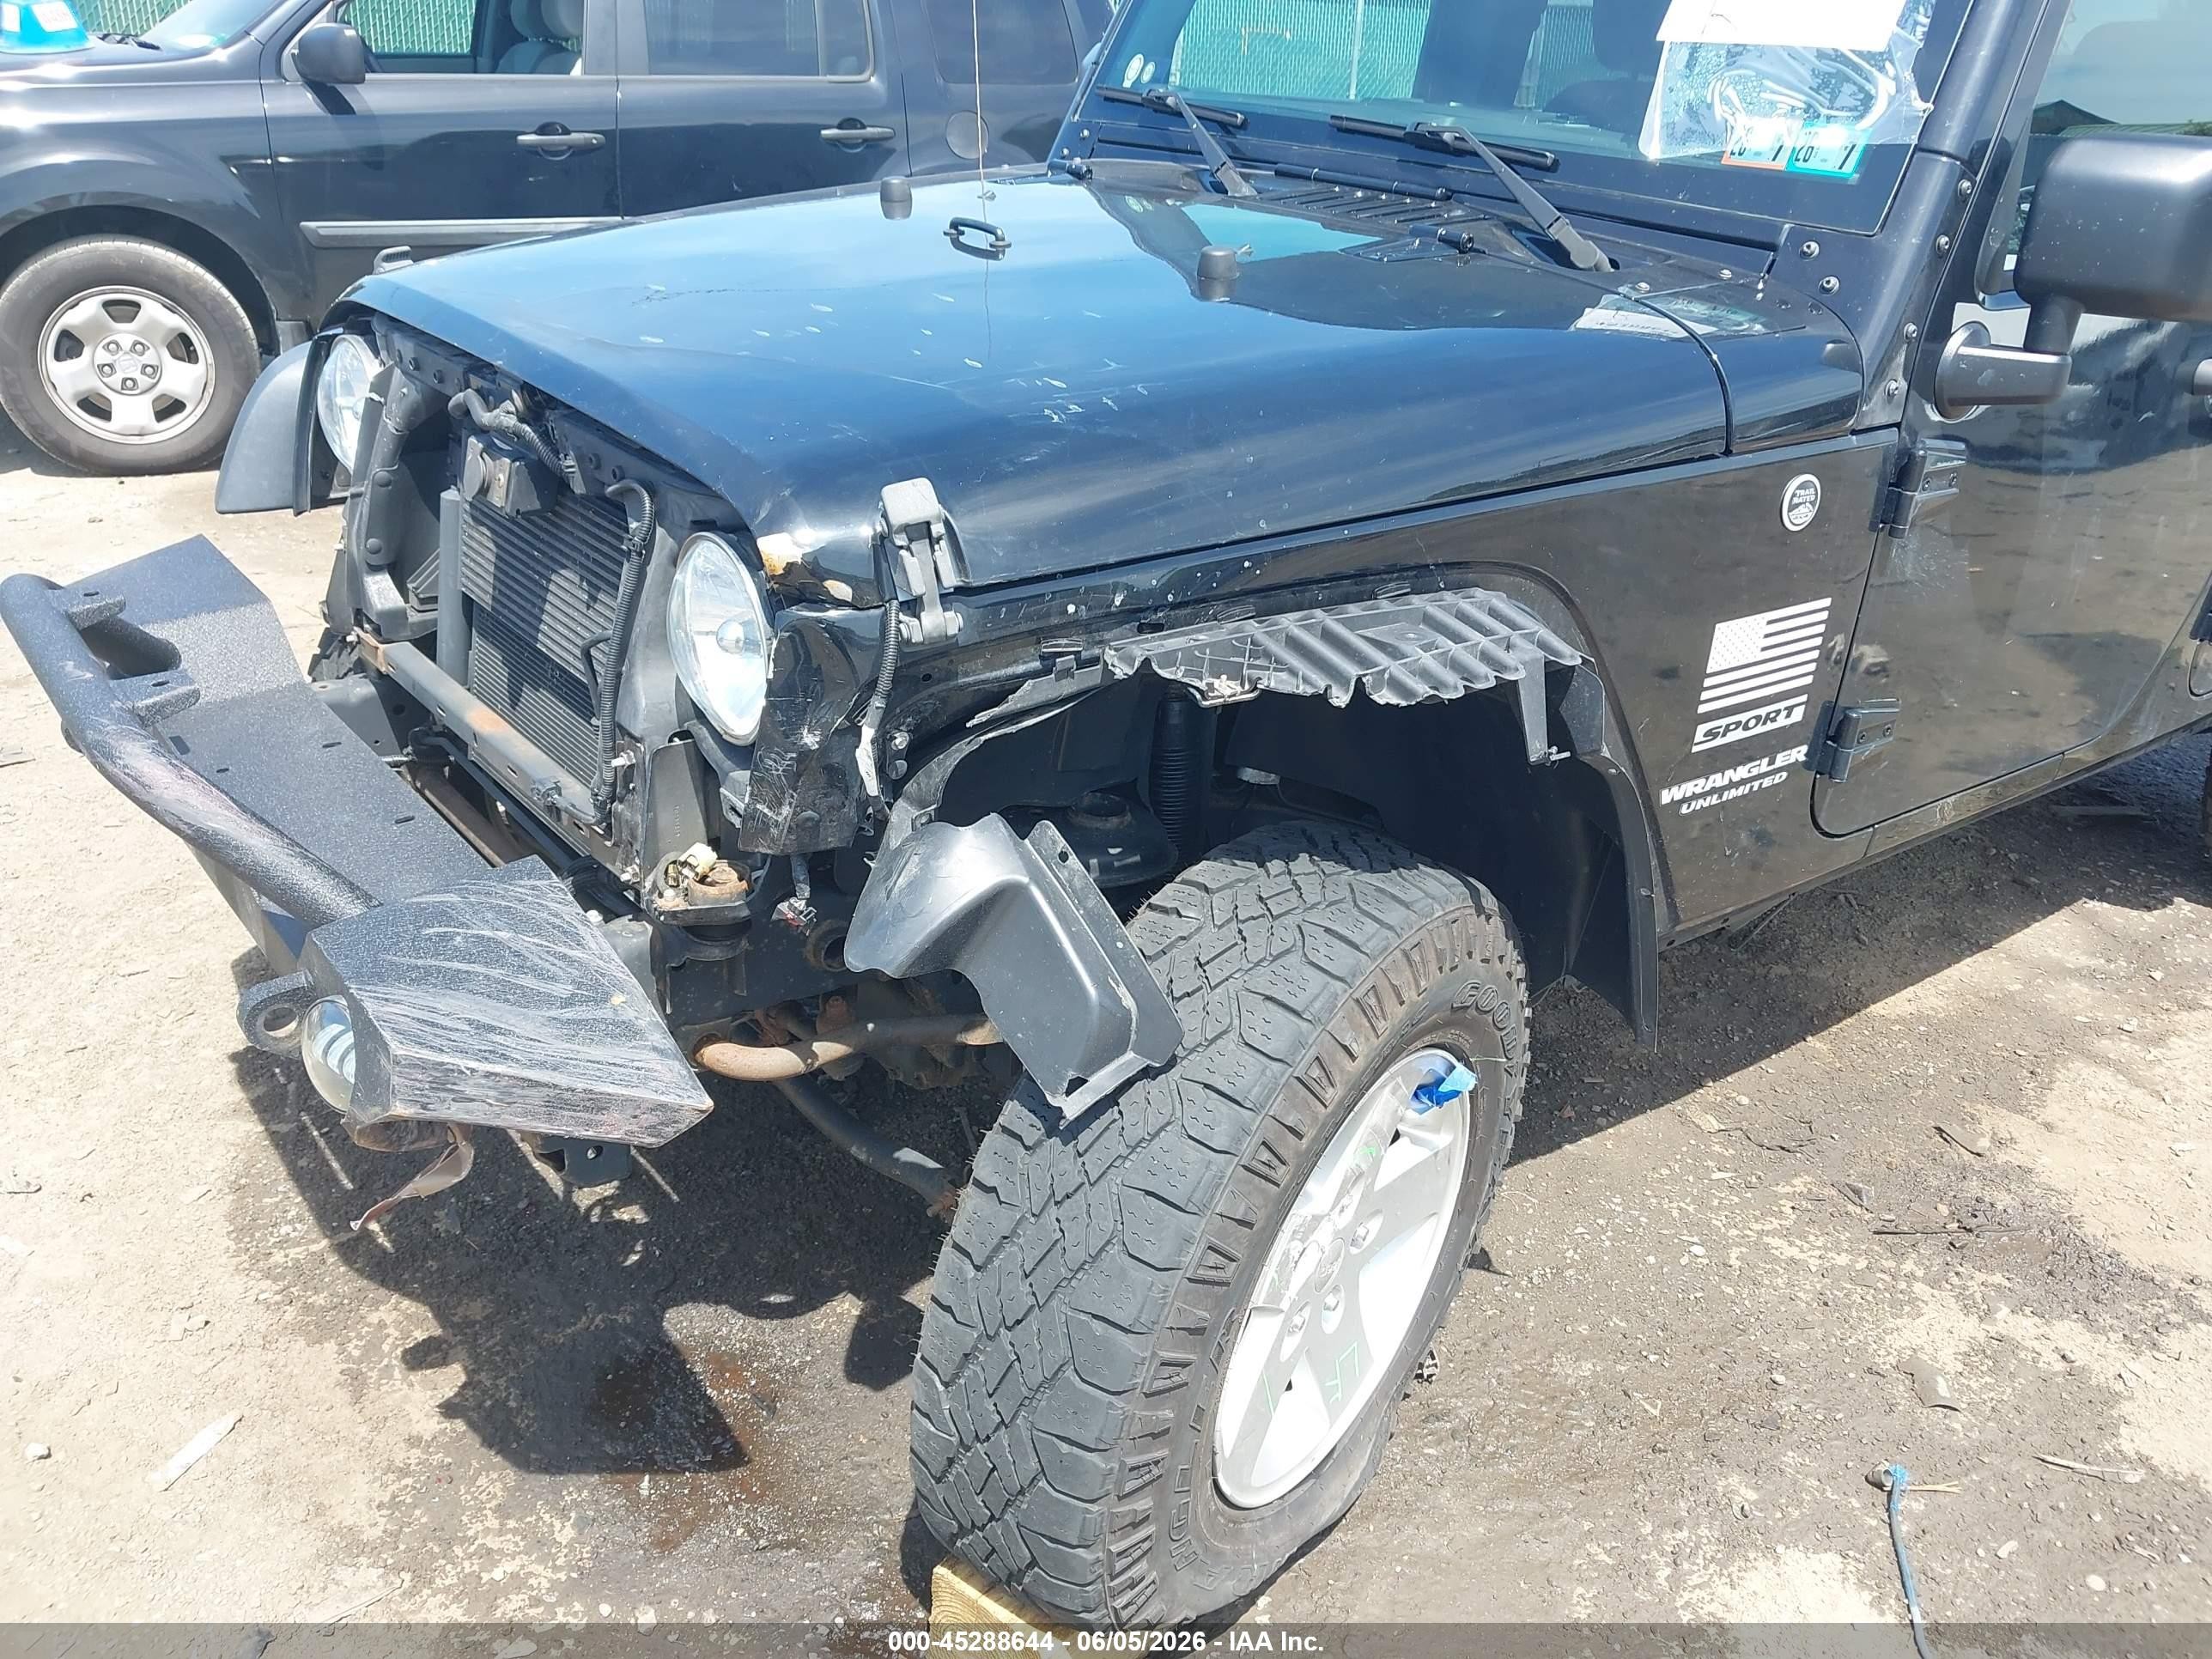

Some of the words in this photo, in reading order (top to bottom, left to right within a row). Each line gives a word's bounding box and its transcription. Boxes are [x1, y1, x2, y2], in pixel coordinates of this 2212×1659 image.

[1791, 495, 1816, 505] RATED
[1794, 488, 1816, 497] TRAIL
[1698, 703, 1803, 744] SPORT
[1659, 744, 1809, 806] WRANGLER
[1680, 771, 1789, 815] UNLIMITED
